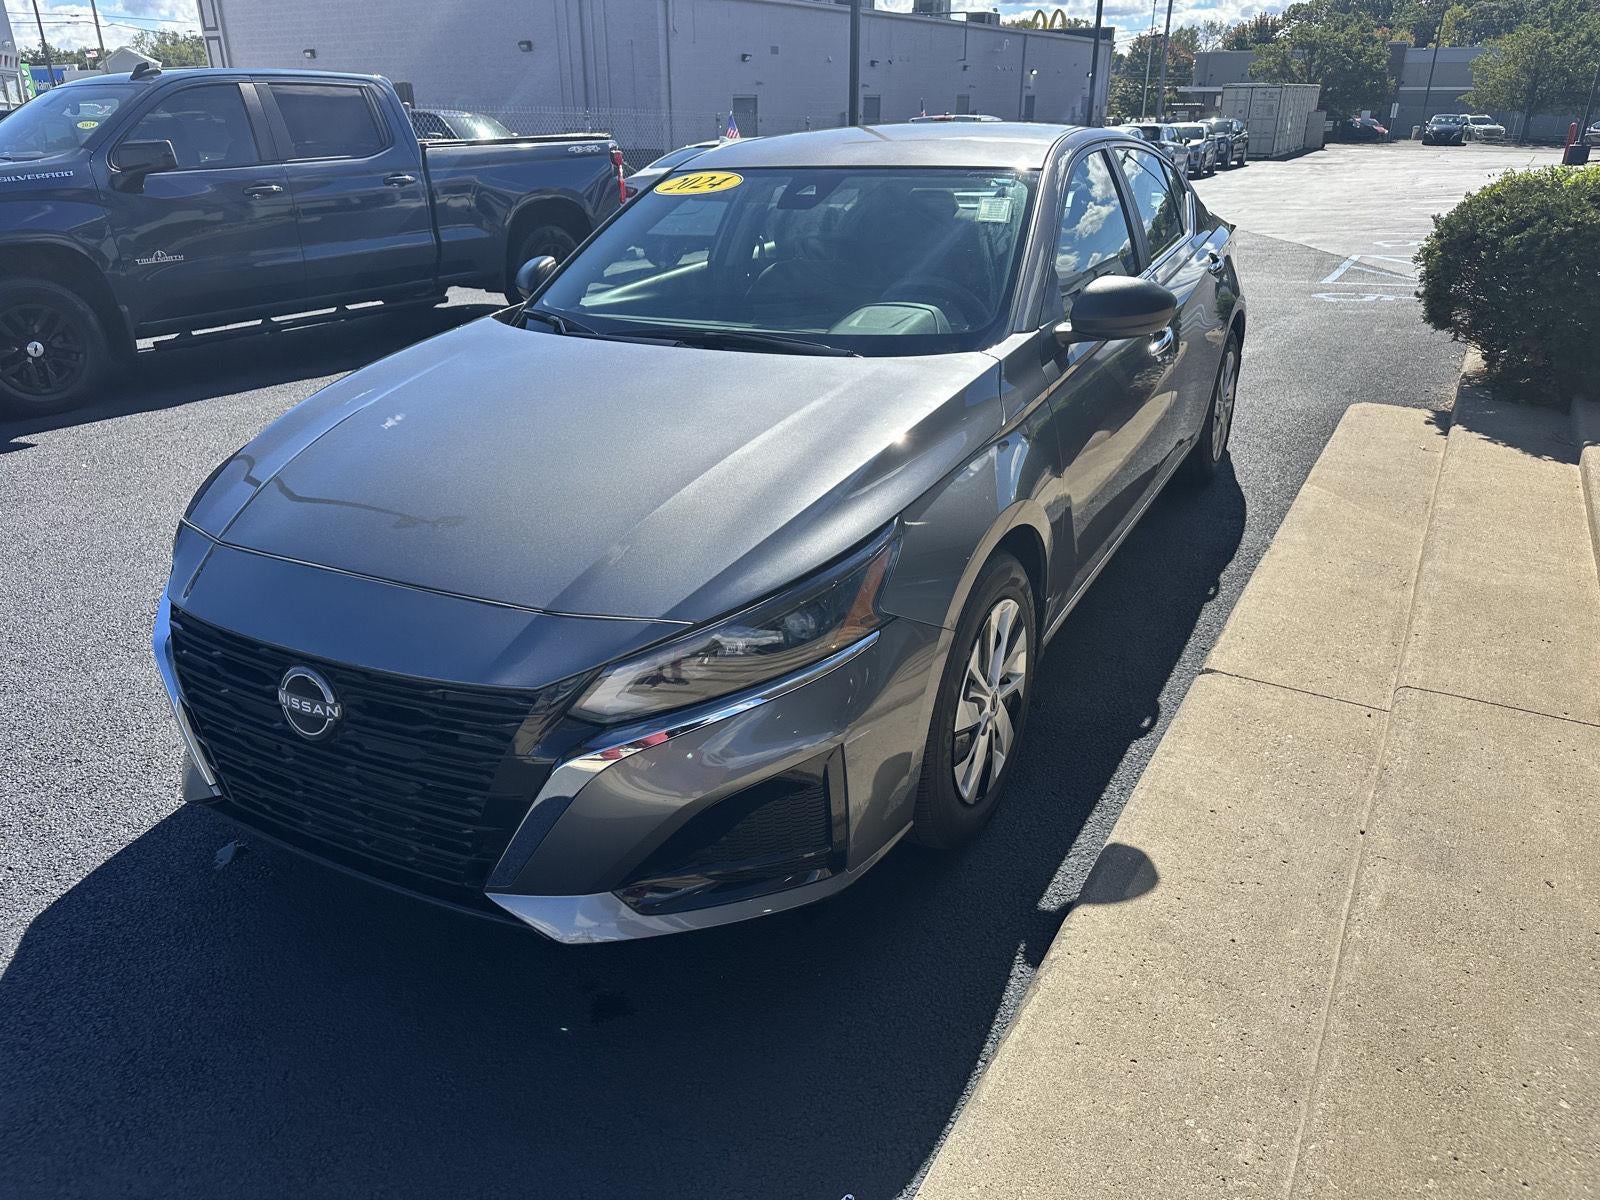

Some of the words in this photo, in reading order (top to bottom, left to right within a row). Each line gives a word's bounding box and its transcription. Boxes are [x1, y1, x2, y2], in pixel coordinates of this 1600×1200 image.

[0, 170, 74, 182] SILVERADO
[661, 175, 735, 191] 2024
[279, 689, 340, 717] NISSAN
